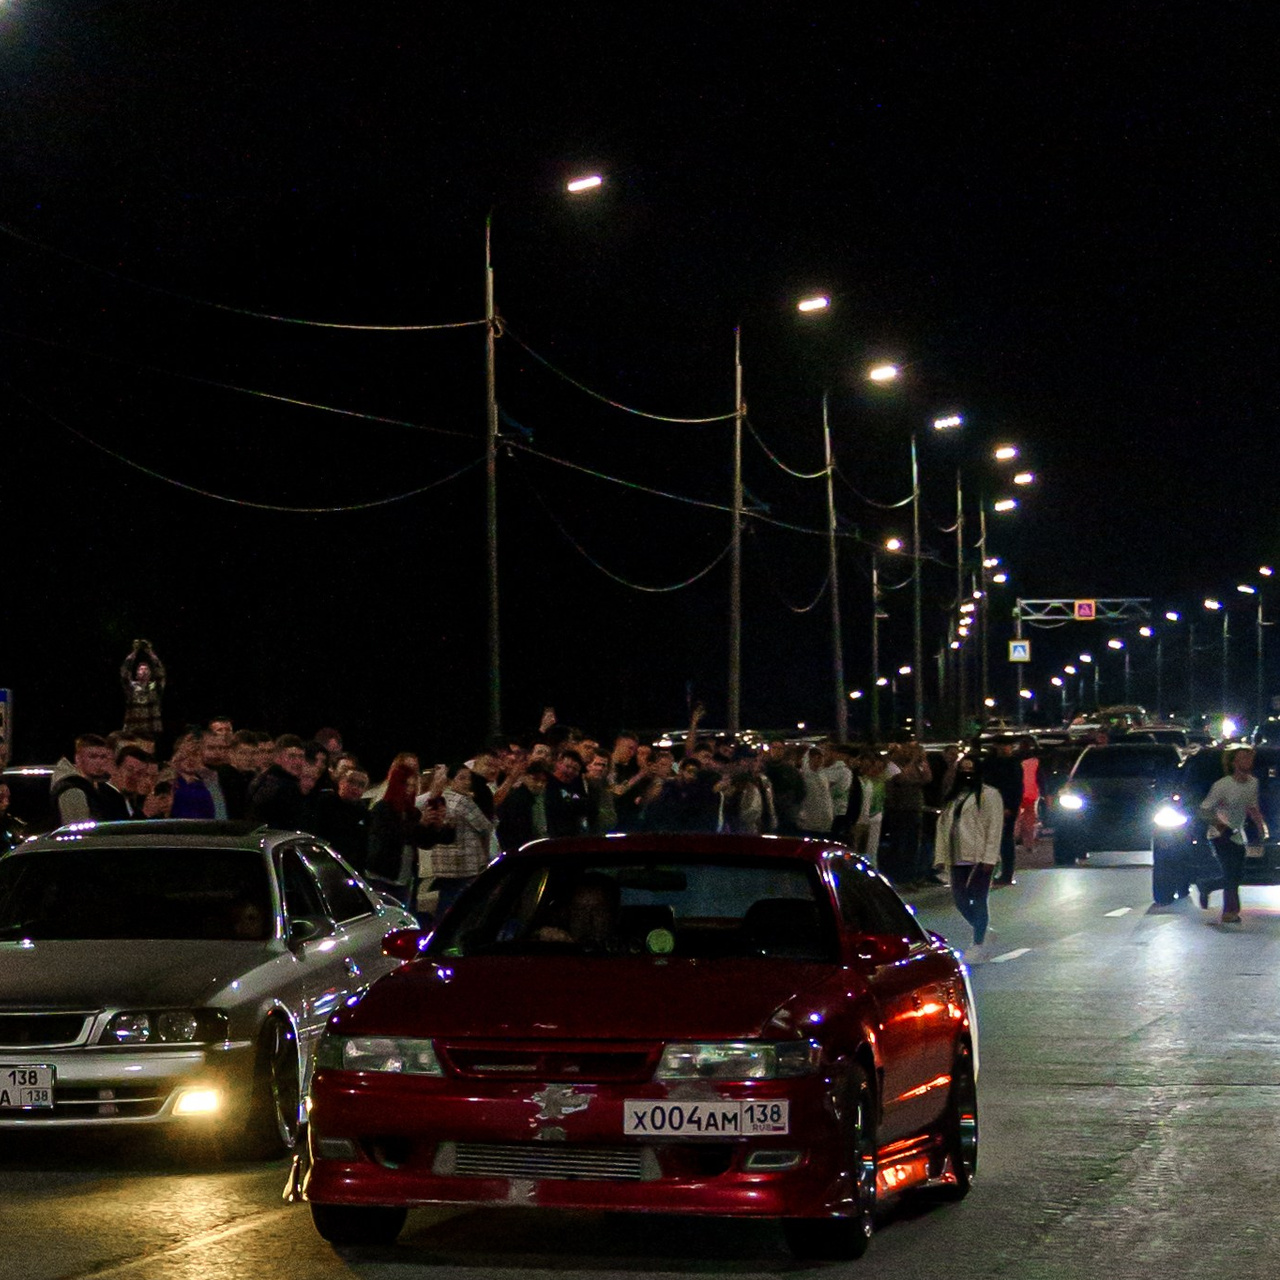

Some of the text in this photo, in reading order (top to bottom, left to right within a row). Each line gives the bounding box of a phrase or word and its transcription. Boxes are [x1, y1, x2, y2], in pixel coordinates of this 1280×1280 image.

[8, 1070, 38, 1086] 138
[27, 1090, 48, 1101] 138
[744, 1104, 781, 1123] 138
